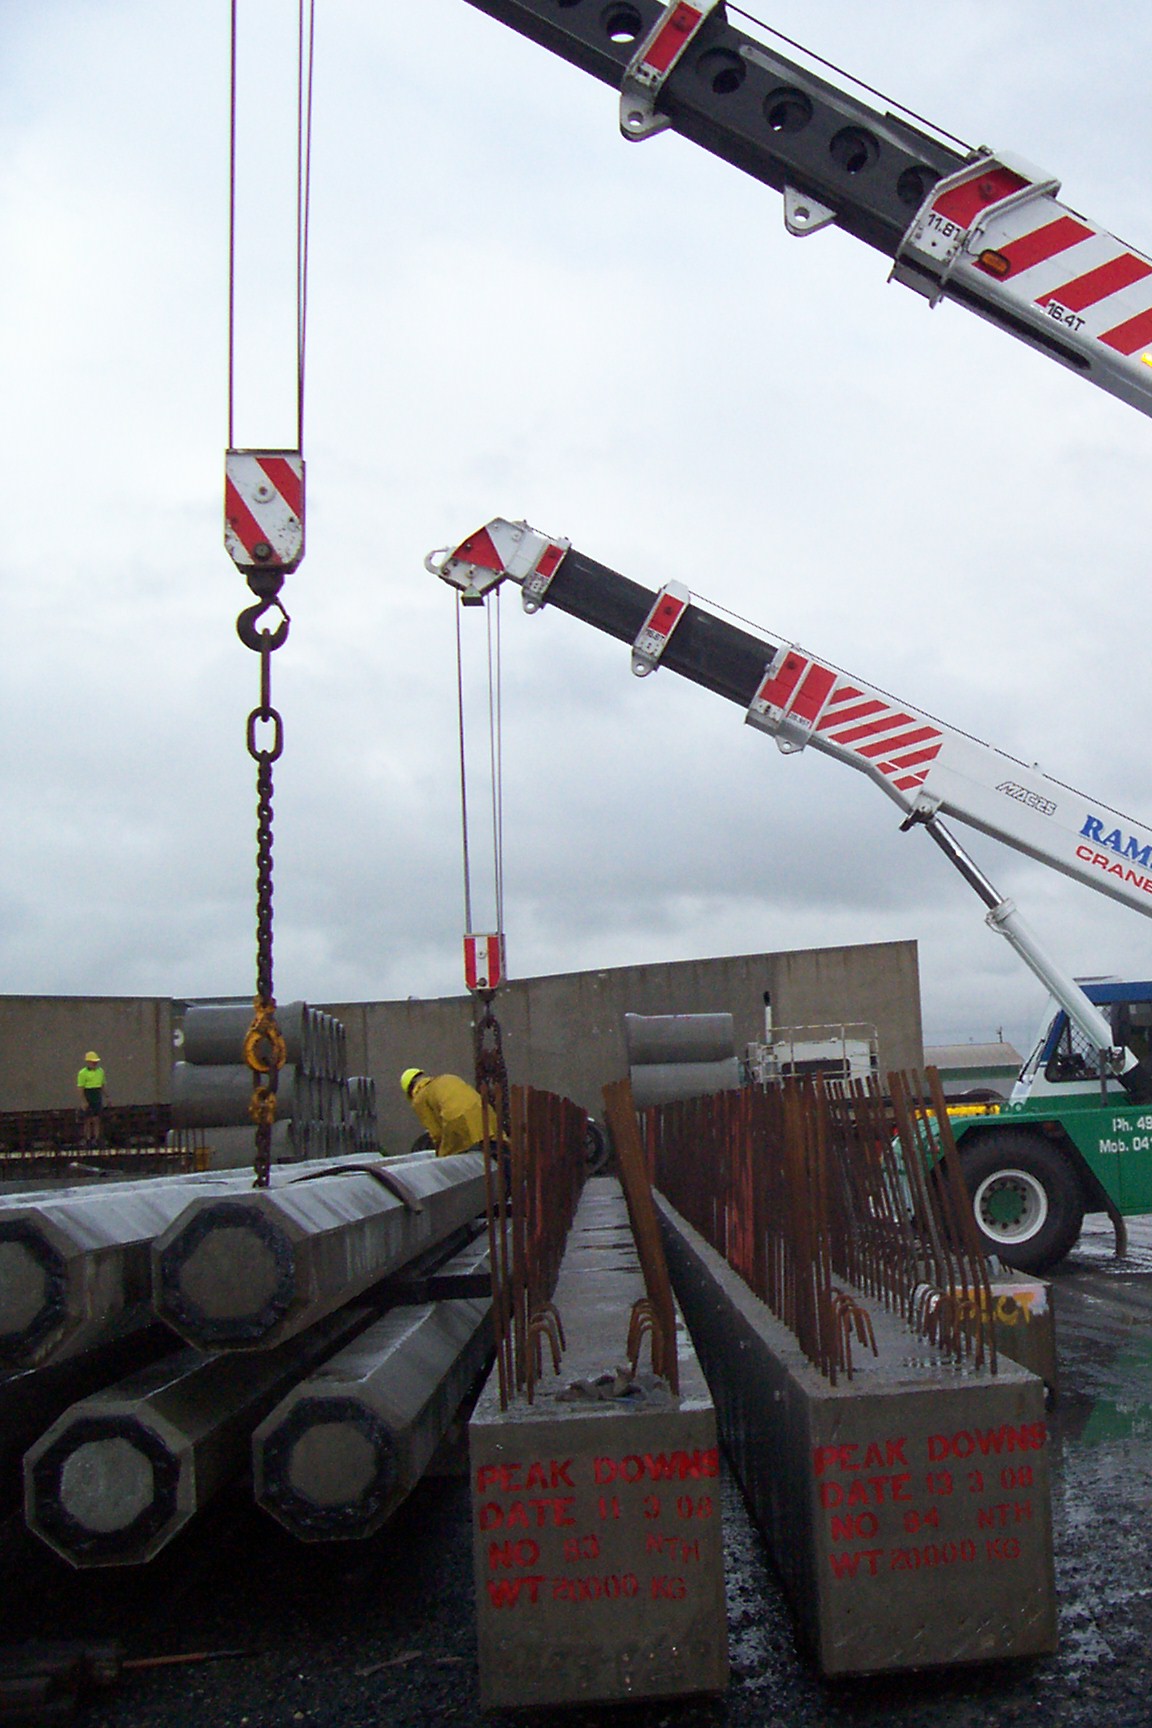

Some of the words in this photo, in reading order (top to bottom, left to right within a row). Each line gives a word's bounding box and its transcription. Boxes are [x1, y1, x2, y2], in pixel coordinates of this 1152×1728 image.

[1048, 302, 1085, 331] 16.4T
[1113, 1118, 1133, 1132] Ph.
[1099, 1139, 1129, 1153] Mob.
[812, 1437, 909, 1477] PEAK
[928, 1420, 1048, 1462] DOWNS
[476, 1458, 575, 1494] PEAK
[593, 1447, 720, 1485] DOWNS
[820, 1473, 912, 1509] DATE
[1001, 1465, 1034, 1490] 08
[479, 1497, 576, 1531] DATE
[831, 1511, 878, 1543] NO
[977, 1500, 1032, 1530] NTH
[488, 1538, 541, 1571] NO
[646, 1532, 700, 1564] NTH
[828, 1549, 884, 1580] WT
[986, 1537, 1021, 1561] KG
[486, 1575, 546, 1609] WT
[651, 1575, 688, 1600] KG
